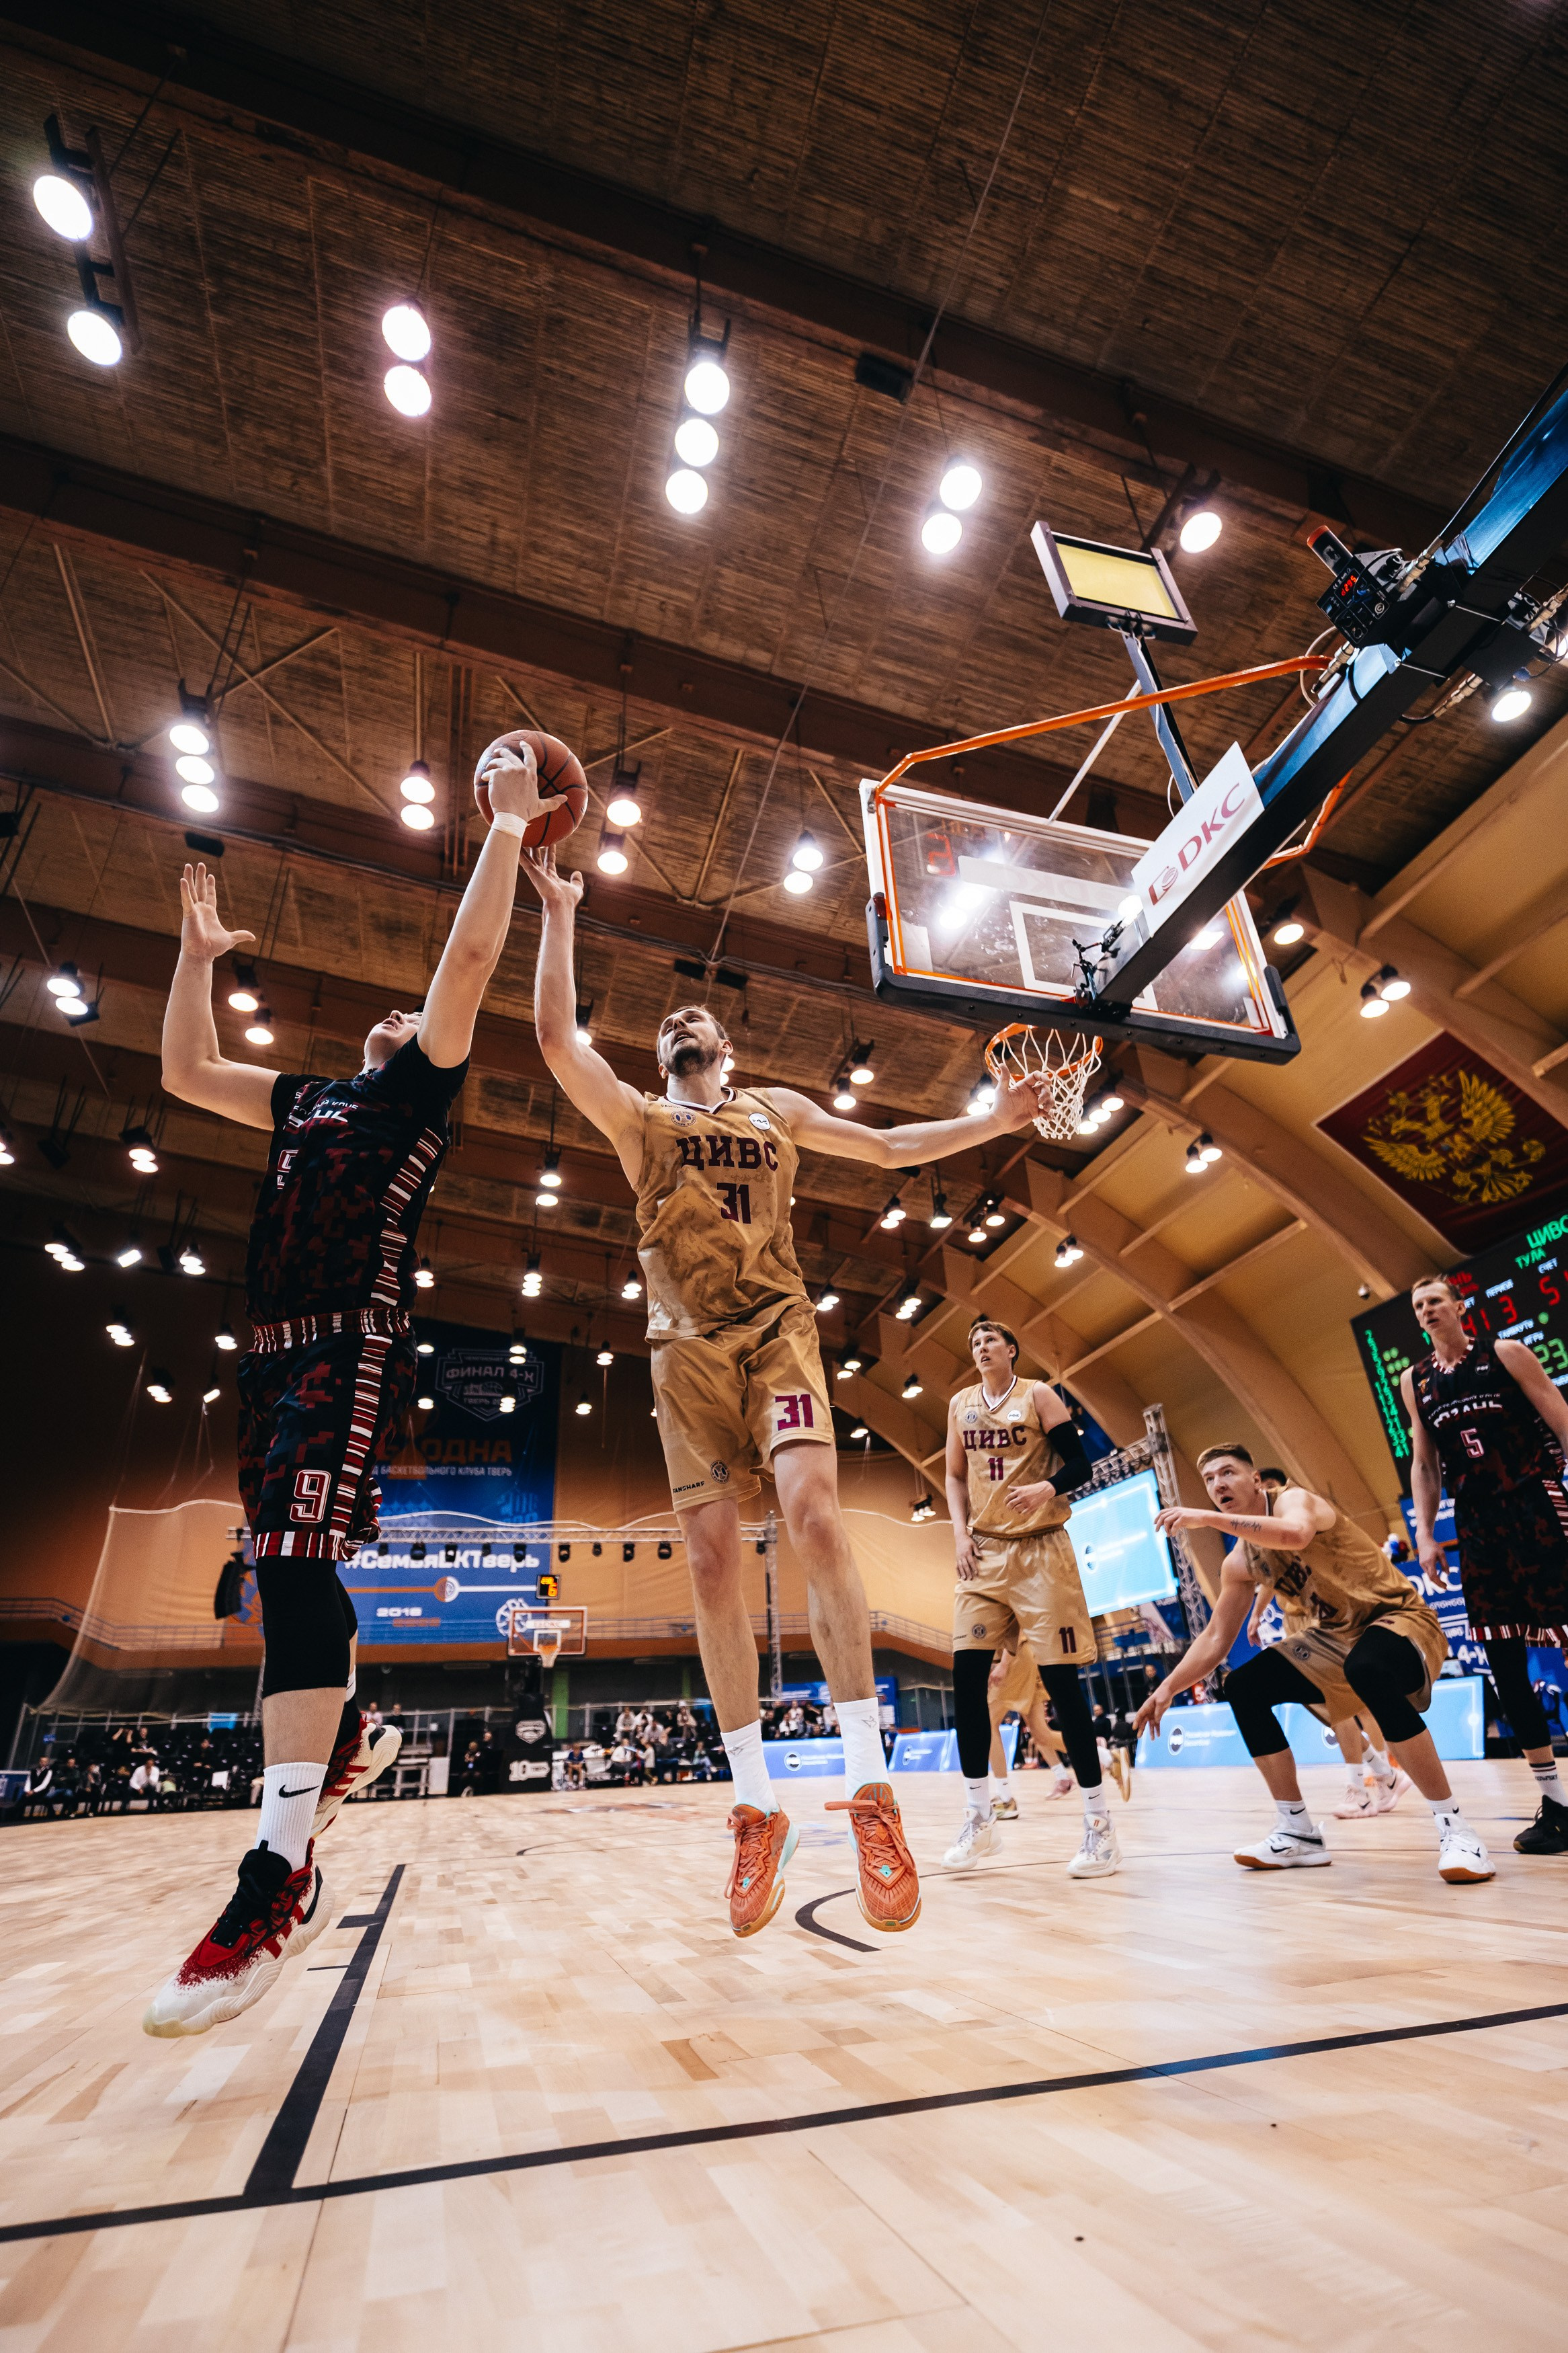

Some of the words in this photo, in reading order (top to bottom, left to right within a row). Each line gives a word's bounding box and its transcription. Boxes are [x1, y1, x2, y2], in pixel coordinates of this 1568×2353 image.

[1178, 783, 1245, 871] DKC
[676, 1135, 778, 1171] ЦИВС
[716, 1183, 751, 1224] 31
[1515, 1246, 1546, 1269] ТУЛА
[1498, 1295, 1518, 1324] 3
[446, 1366, 504, 1379] ФИНАЛ
[775, 1394, 814, 1431] 31
[421, 1438, 513, 1464] ОДНА
[963, 1425, 1027, 1451] ЦИВС
[1460, 1427, 1485, 1459] 5
[458, 1467, 485, 1476] КЛУБА
[487, 1467, 512, 1477] ТВЕРЬ
[987, 1458, 1004, 1481] 11
[290, 1470, 331, 1523] 9
[1058, 1626, 1077, 1654] 11
